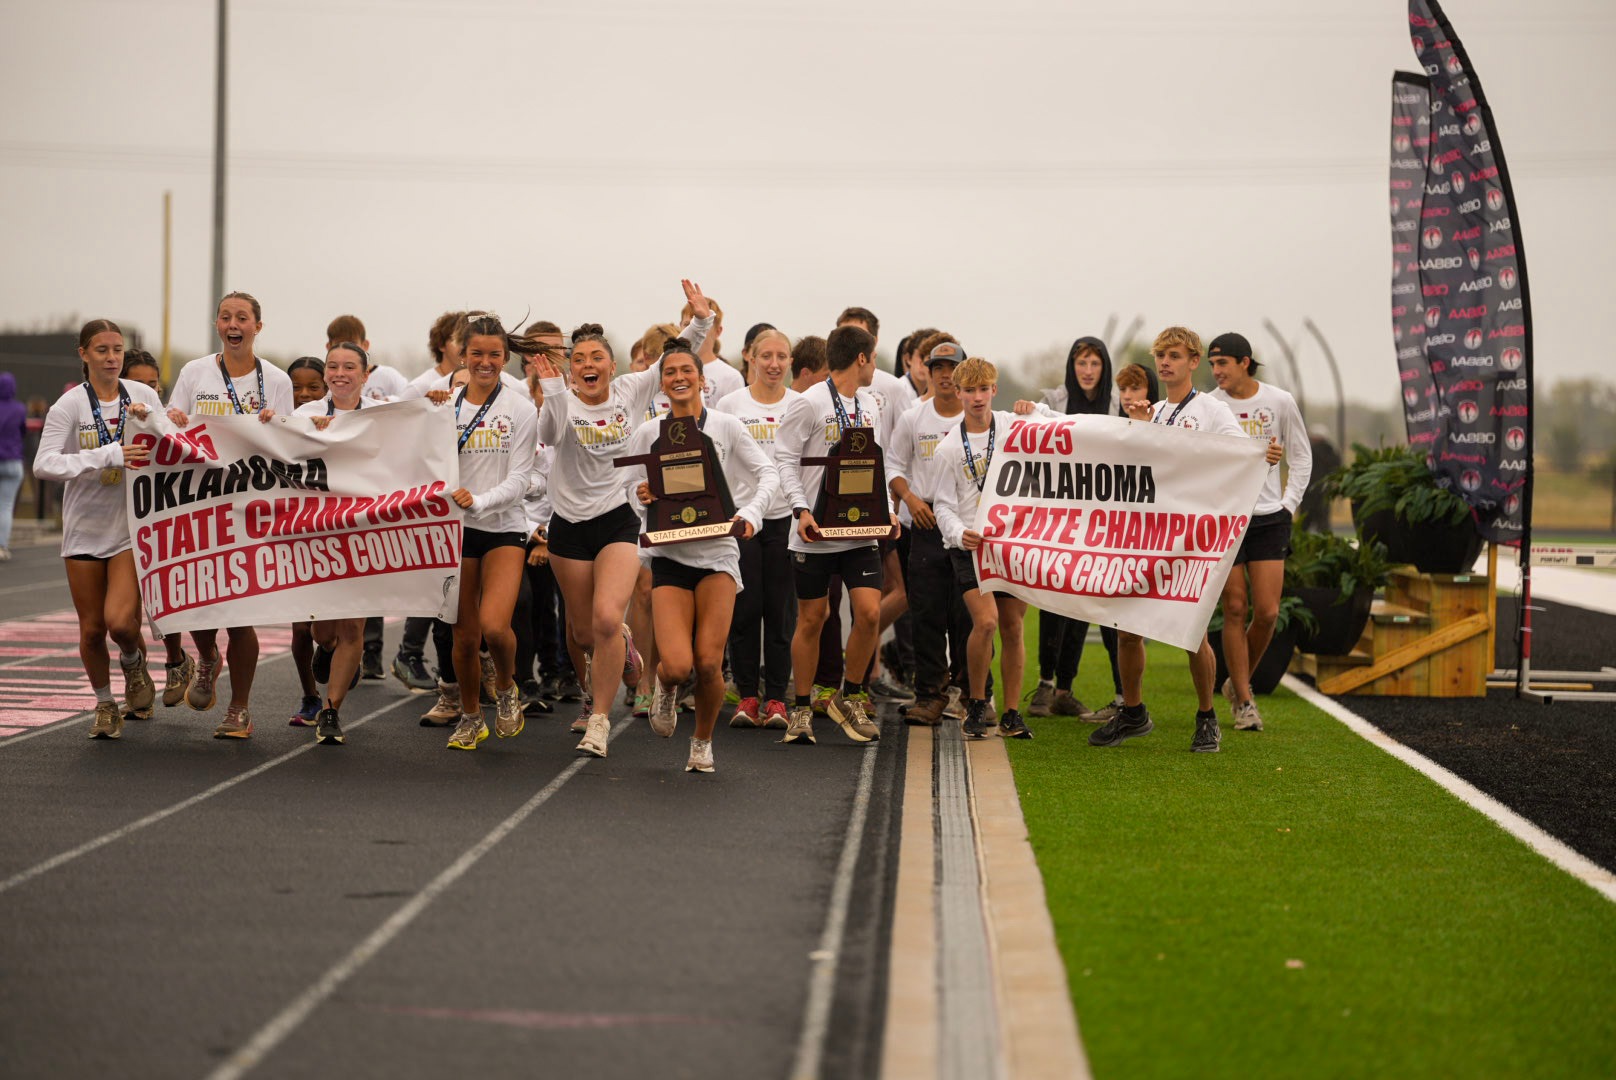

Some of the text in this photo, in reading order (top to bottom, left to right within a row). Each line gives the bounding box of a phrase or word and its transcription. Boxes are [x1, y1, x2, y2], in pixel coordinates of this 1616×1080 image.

[79, 423, 98, 431] CROS
[196, 401, 234, 415] COUNT
[1003, 420, 1076, 455] 2025
[132, 454, 330, 520] OKLAHOMA
[995, 460, 1155, 503] OKLAHOMA
[137, 480, 450, 570] STATE CHAMPIONS
[653, 525, 727, 541] STATE CHAMPION
[824, 527, 887, 537] STATE CHAMPION
[983, 504, 1248, 553] STATE CHAMPIONS
[168, 551, 249, 609] GIRLS
[255, 537, 348, 590] CROSS
[348, 524, 460, 573] COUNTRY
[981, 542, 1218, 598] 4A BOYS CROSS COUNT
